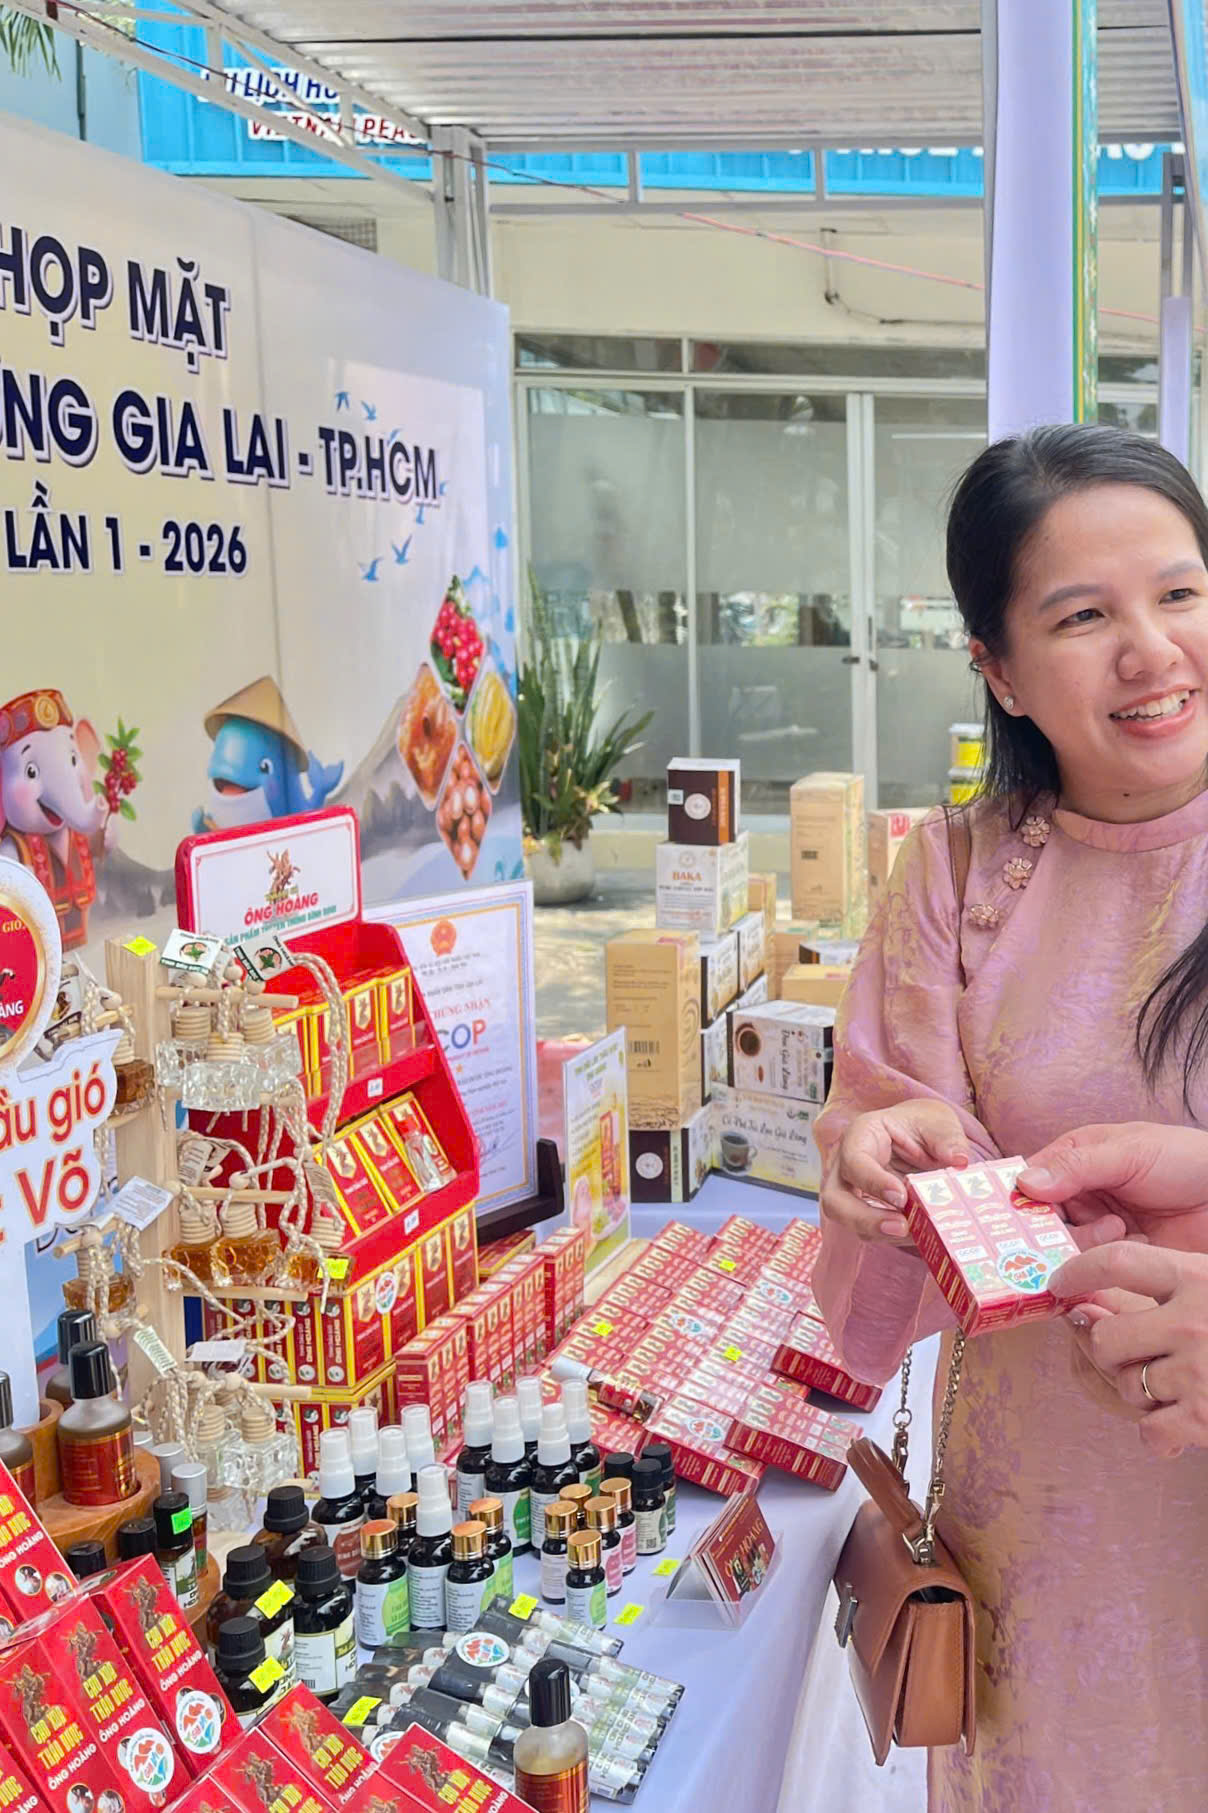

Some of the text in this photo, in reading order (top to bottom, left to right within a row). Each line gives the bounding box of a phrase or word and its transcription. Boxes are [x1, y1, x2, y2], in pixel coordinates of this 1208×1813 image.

[127, 257, 228, 370] MẶT
[0, 368, 93, 457] NG
[113, 389, 208, 471] GIA
[224, 408, 286, 482] LAI
[319, 427, 438, 500] TP.HCM
[5, 480, 89, 569] LẦN
[105, 516, 122, 569] 1
[164, 520, 247, 573] 2026
[244, 906, 273, 926] ÔNG
[276, 892, 319, 916] HOÀNG
[48, 1063, 107, 1144] gió
[16, 1148, 90, 1228] Võ
